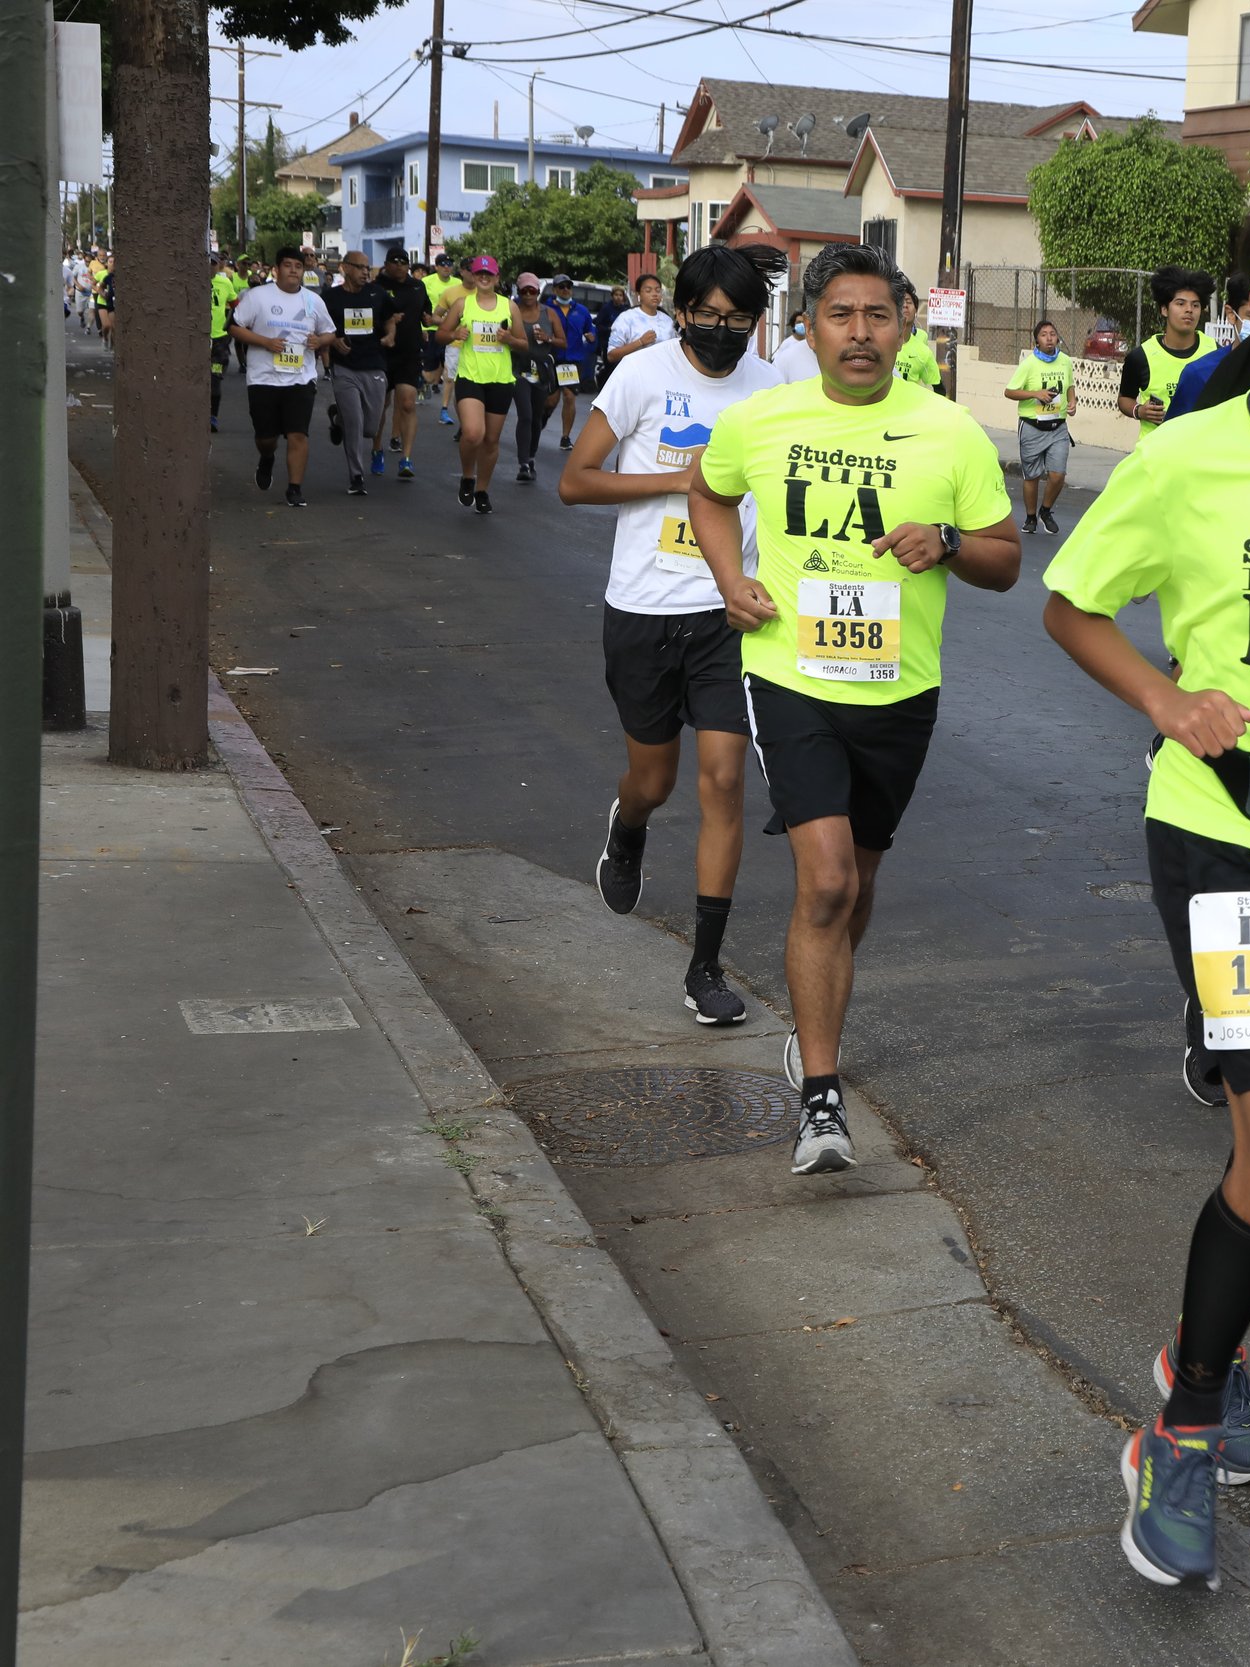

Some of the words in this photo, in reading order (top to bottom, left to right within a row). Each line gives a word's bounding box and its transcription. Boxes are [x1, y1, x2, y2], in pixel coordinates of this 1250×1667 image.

[930, 298, 941, 307] NO
[942, 300, 963, 309] STOPPING
[279, 354, 299, 364] 1368
[665, 390, 692, 398] Students
[664, 399, 691, 418] LA
[658, 449, 684, 465] SRLA
[787, 443, 898, 472] Students
[783, 461, 897, 489] run
[783, 478, 887, 545] LA
[831, 551, 845, 560] The
[831, 560, 864, 570] McCourt
[831, 568, 873, 578] Foundation
[829, 583, 865, 591] Students
[830, 589, 864, 597] run
[828, 595, 864, 617] LA
[814, 620, 884, 650] 1358
[822, 665, 857, 676] HORACIO
[869, 669, 895, 680] 1358
